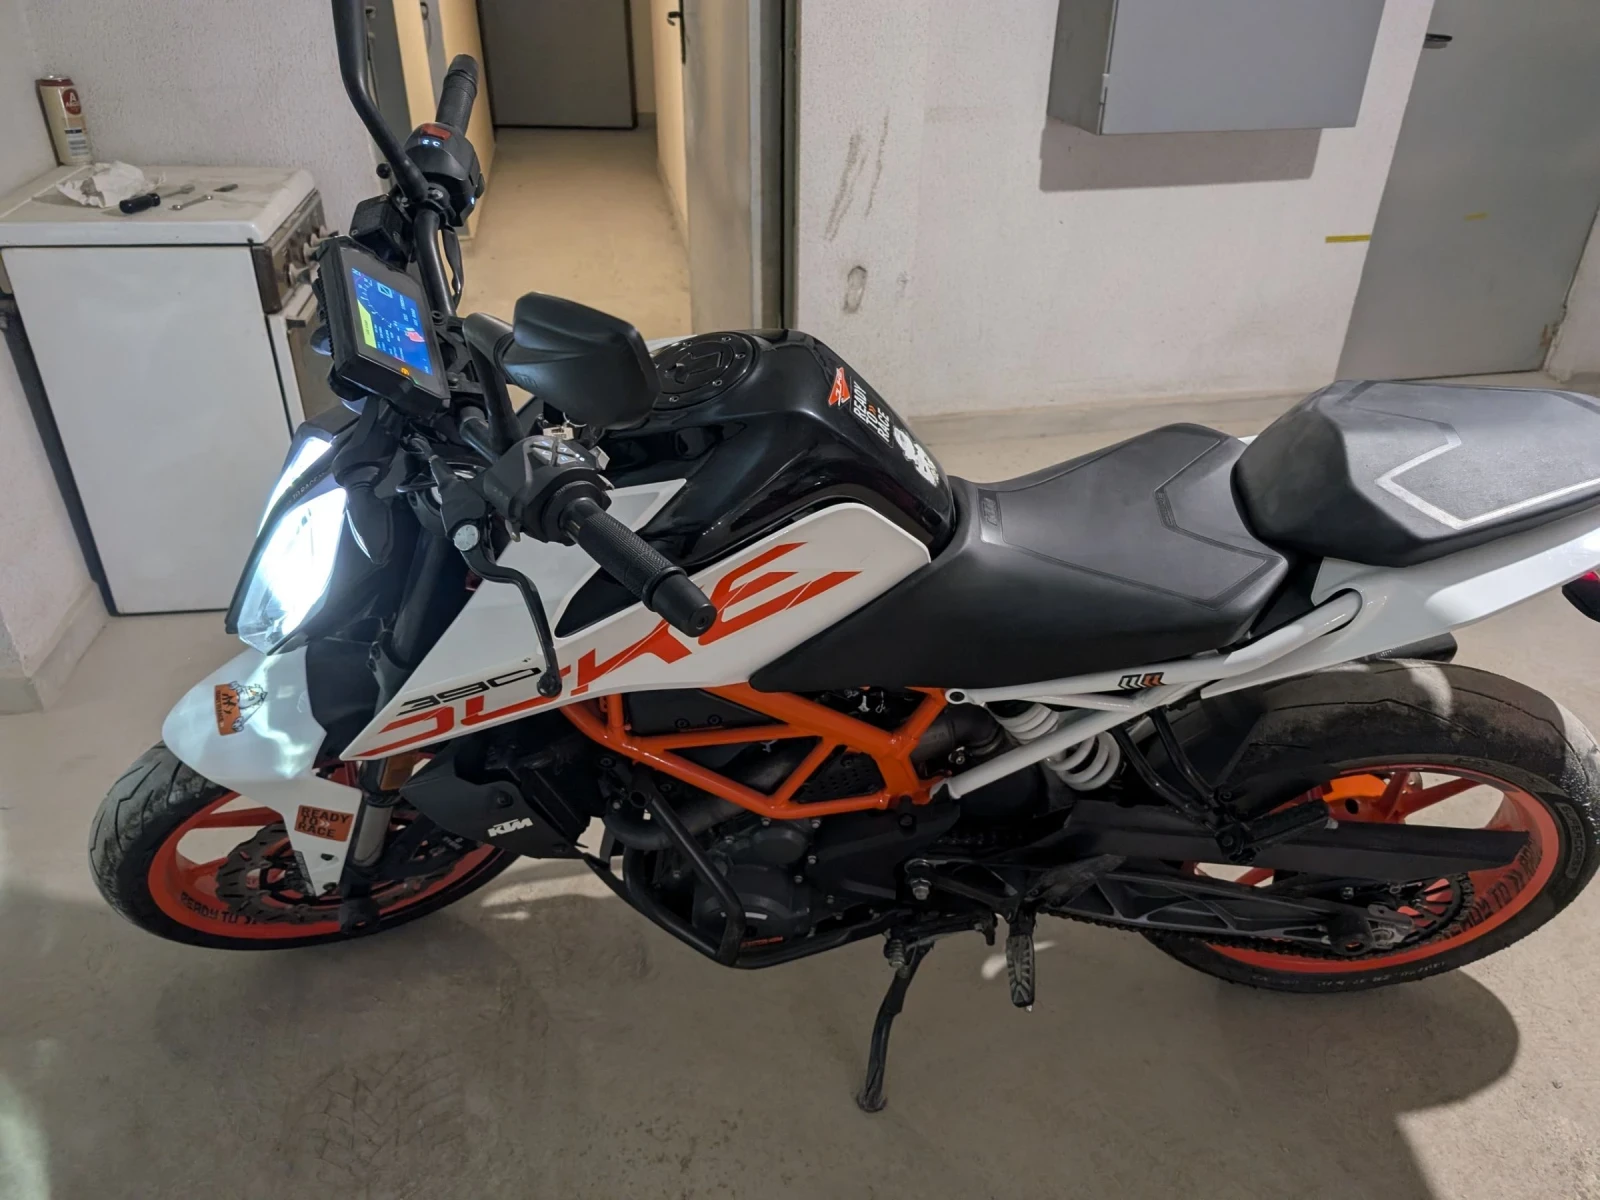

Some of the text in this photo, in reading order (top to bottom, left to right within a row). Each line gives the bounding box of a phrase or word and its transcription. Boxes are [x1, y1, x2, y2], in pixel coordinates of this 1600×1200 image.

[853, 381, 867, 421] READY
[866, 409, 879, 430] TO
[877, 407, 890, 443] RACE
[355, 541, 863, 758] DUKE
[396, 667, 542, 717] 390
[301, 806, 349, 824] READY
[302, 815, 318, 826] TO
[298, 821, 337, 838] RACE
[487, 817, 534, 838] KTM
